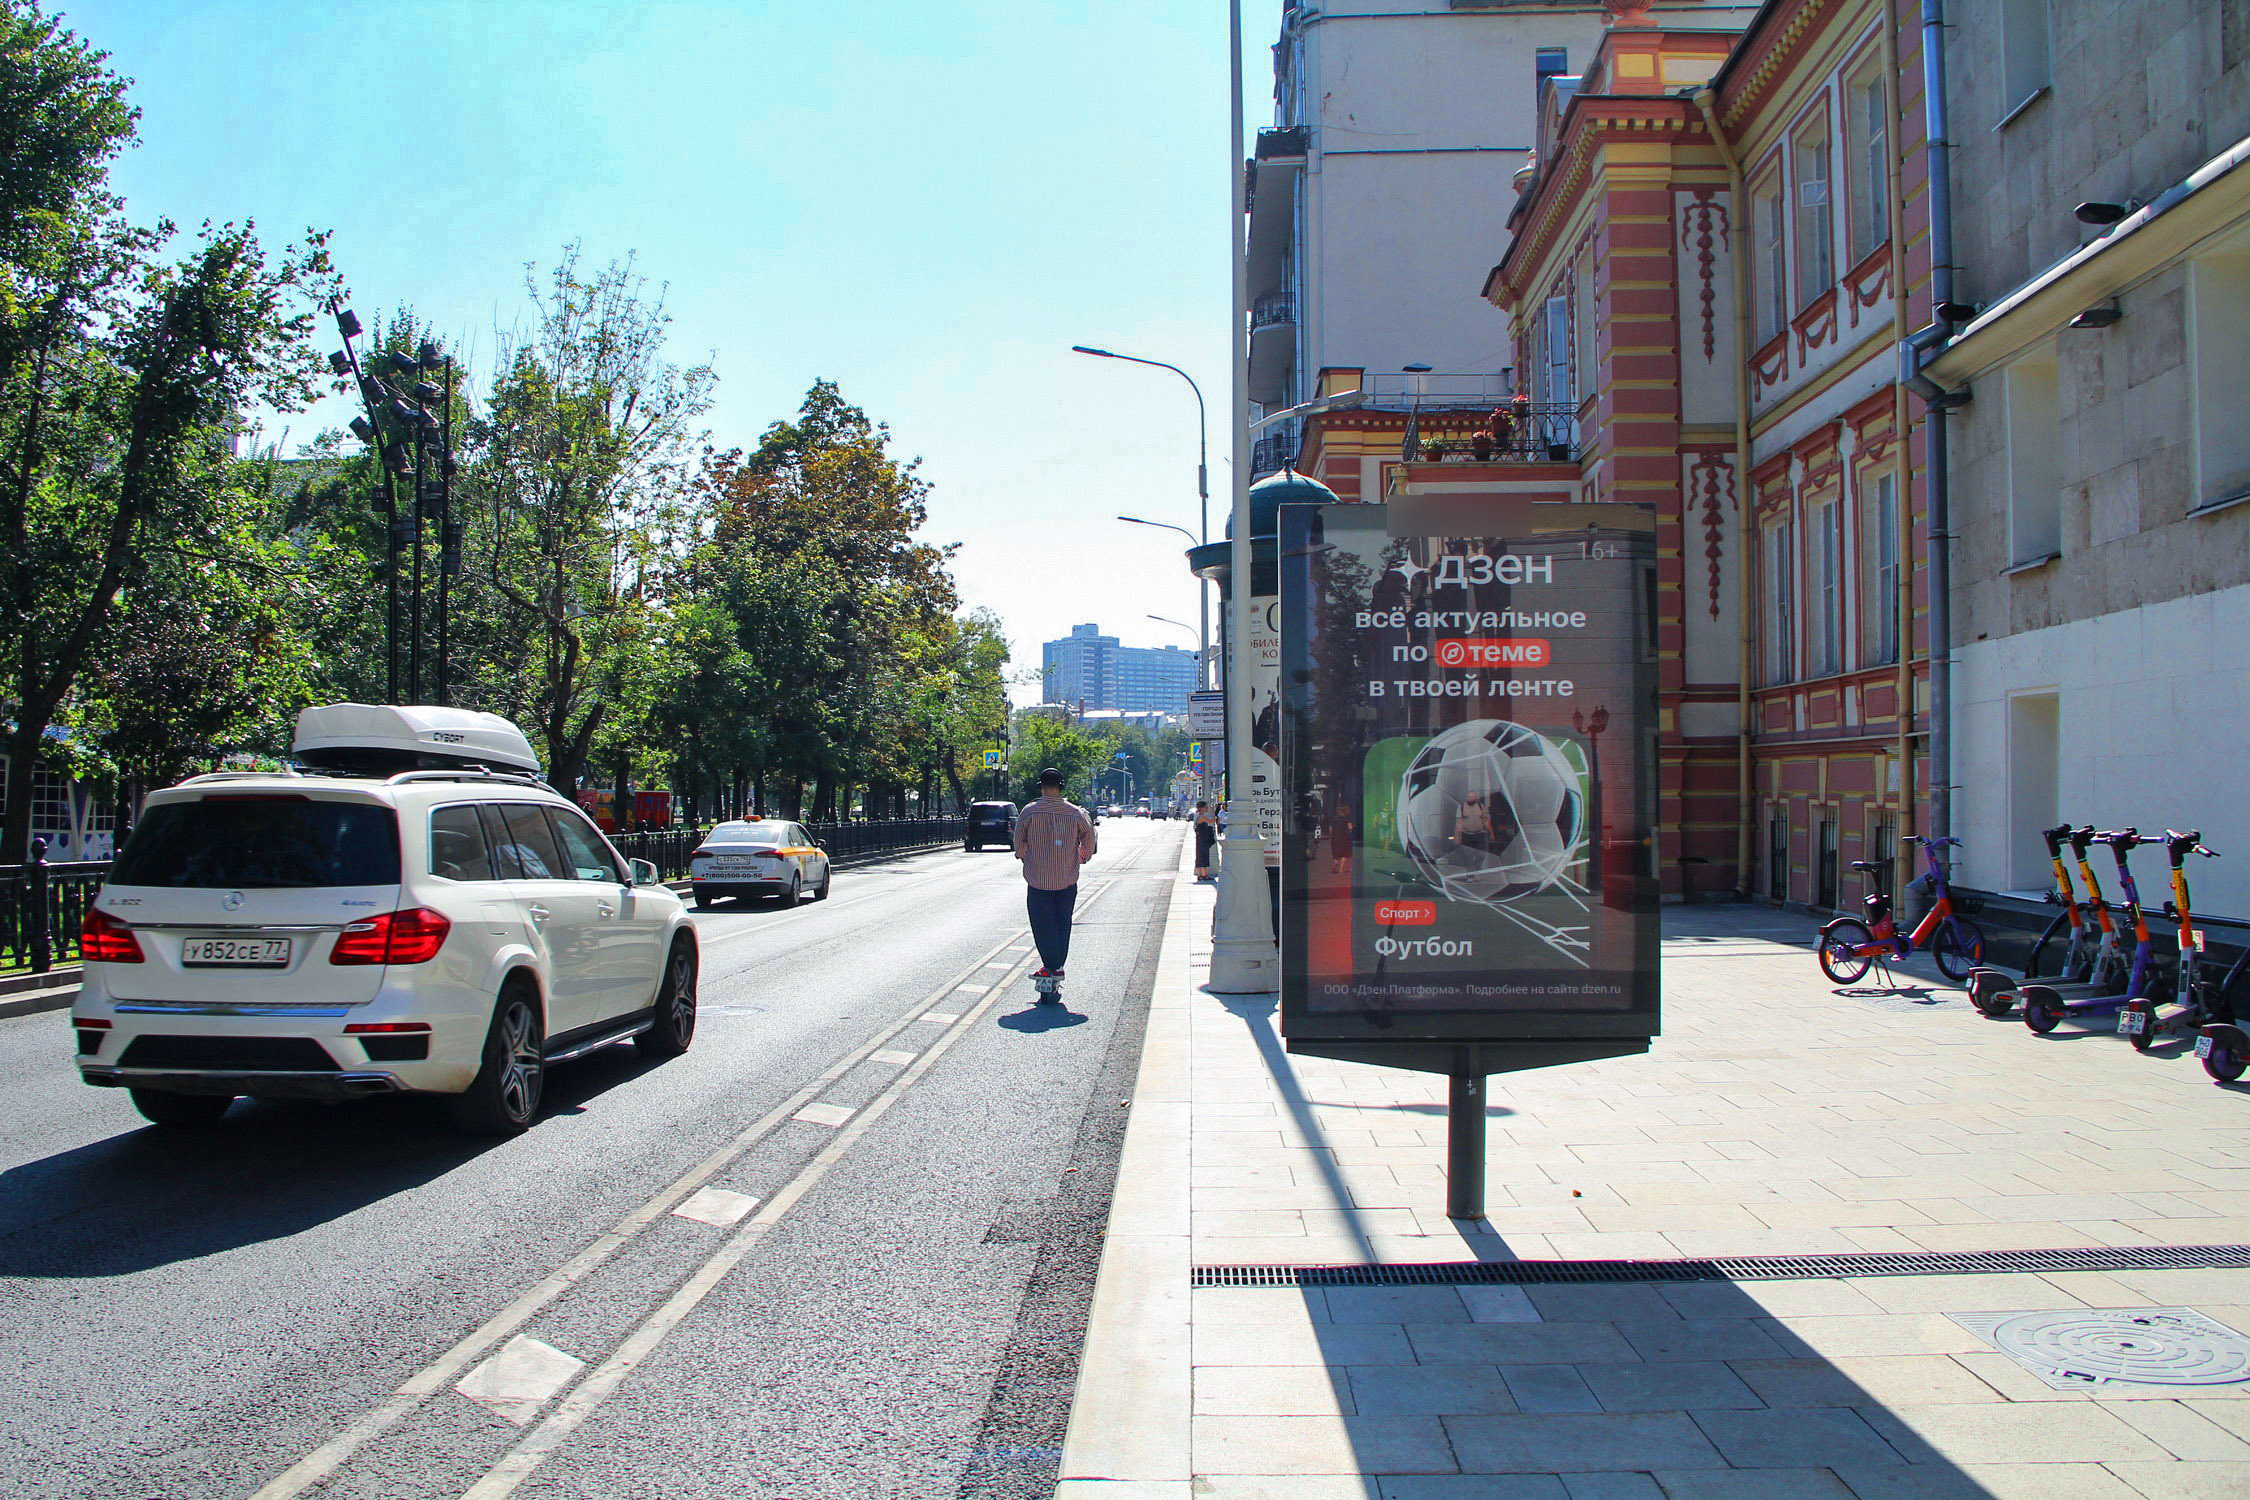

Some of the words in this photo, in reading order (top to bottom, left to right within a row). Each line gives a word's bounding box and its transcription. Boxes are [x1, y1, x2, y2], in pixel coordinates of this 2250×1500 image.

[1577, 541, 1619, 561] 16+
[1355, 606, 1406, 628] всё
[1414, 609, 1586, 634] актуальное
[1251, 638, 1279, 648] БИЛЕ
[1393, 646, 1428, 662] по
[1468, 645, 1542, 662] теме
[1369, 680, 1385, 697] в
[1394, 674, 1480, 697] твоей
[1488, 678, 1574, 697] ленте
[1379, 907, 1420, 923] Спорт
[265, 941, 283, 955] 77
[1374, 936, 1473, 961] Футбол
[1323, 984, 1349, 995] ООО
[1466, 984, 1529, 997] Подробнее
[1531, 985, 1545, 995] на
[1547, 984, 1579, 995] сайте
[1581, 983, 1622, 995] dzen.ru
